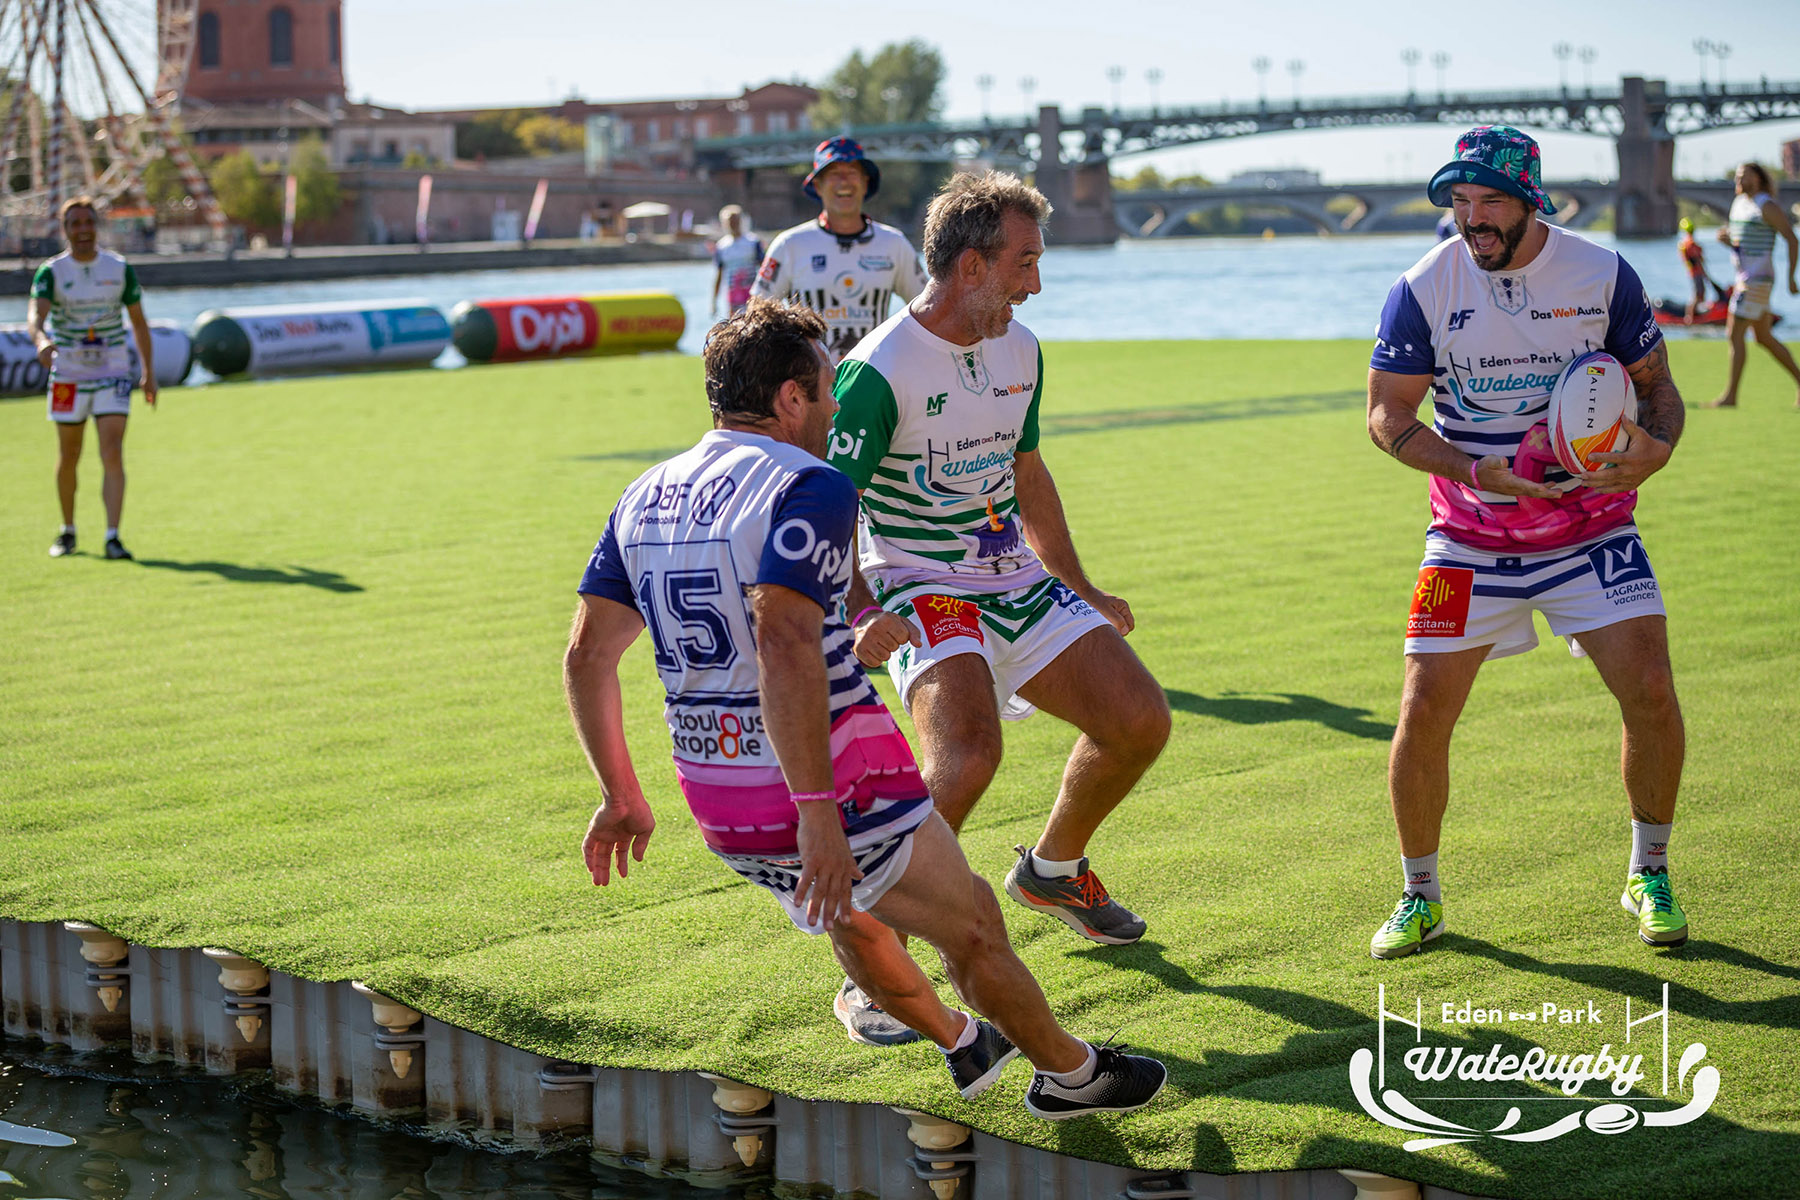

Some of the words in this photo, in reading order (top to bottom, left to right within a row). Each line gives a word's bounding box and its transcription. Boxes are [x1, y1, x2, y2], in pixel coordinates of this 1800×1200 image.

[509, 302, 586, 354] Orpi
[1480, 356, 1511, 368] Eden
[1530, 352, 1562, 363] Park
[1467, 373, 1561, 393] WateRug
[1587, 376, 1598, 429] ALTEN
[957, 437, 980, 451] Eden
[995, 429, 1016, 441] Park
[941, 445, 1016, 477] WateRug
[1606, 581, 1657, 599] LAGRANGE
[1614, 591, 1655, 605] vacances
[638, 568, 739, 673] 15
[1408, 619, 1456, 629] Occitanie
[674, 708, 765, 737] toulous
[673, 730, 761, 759] tropole
